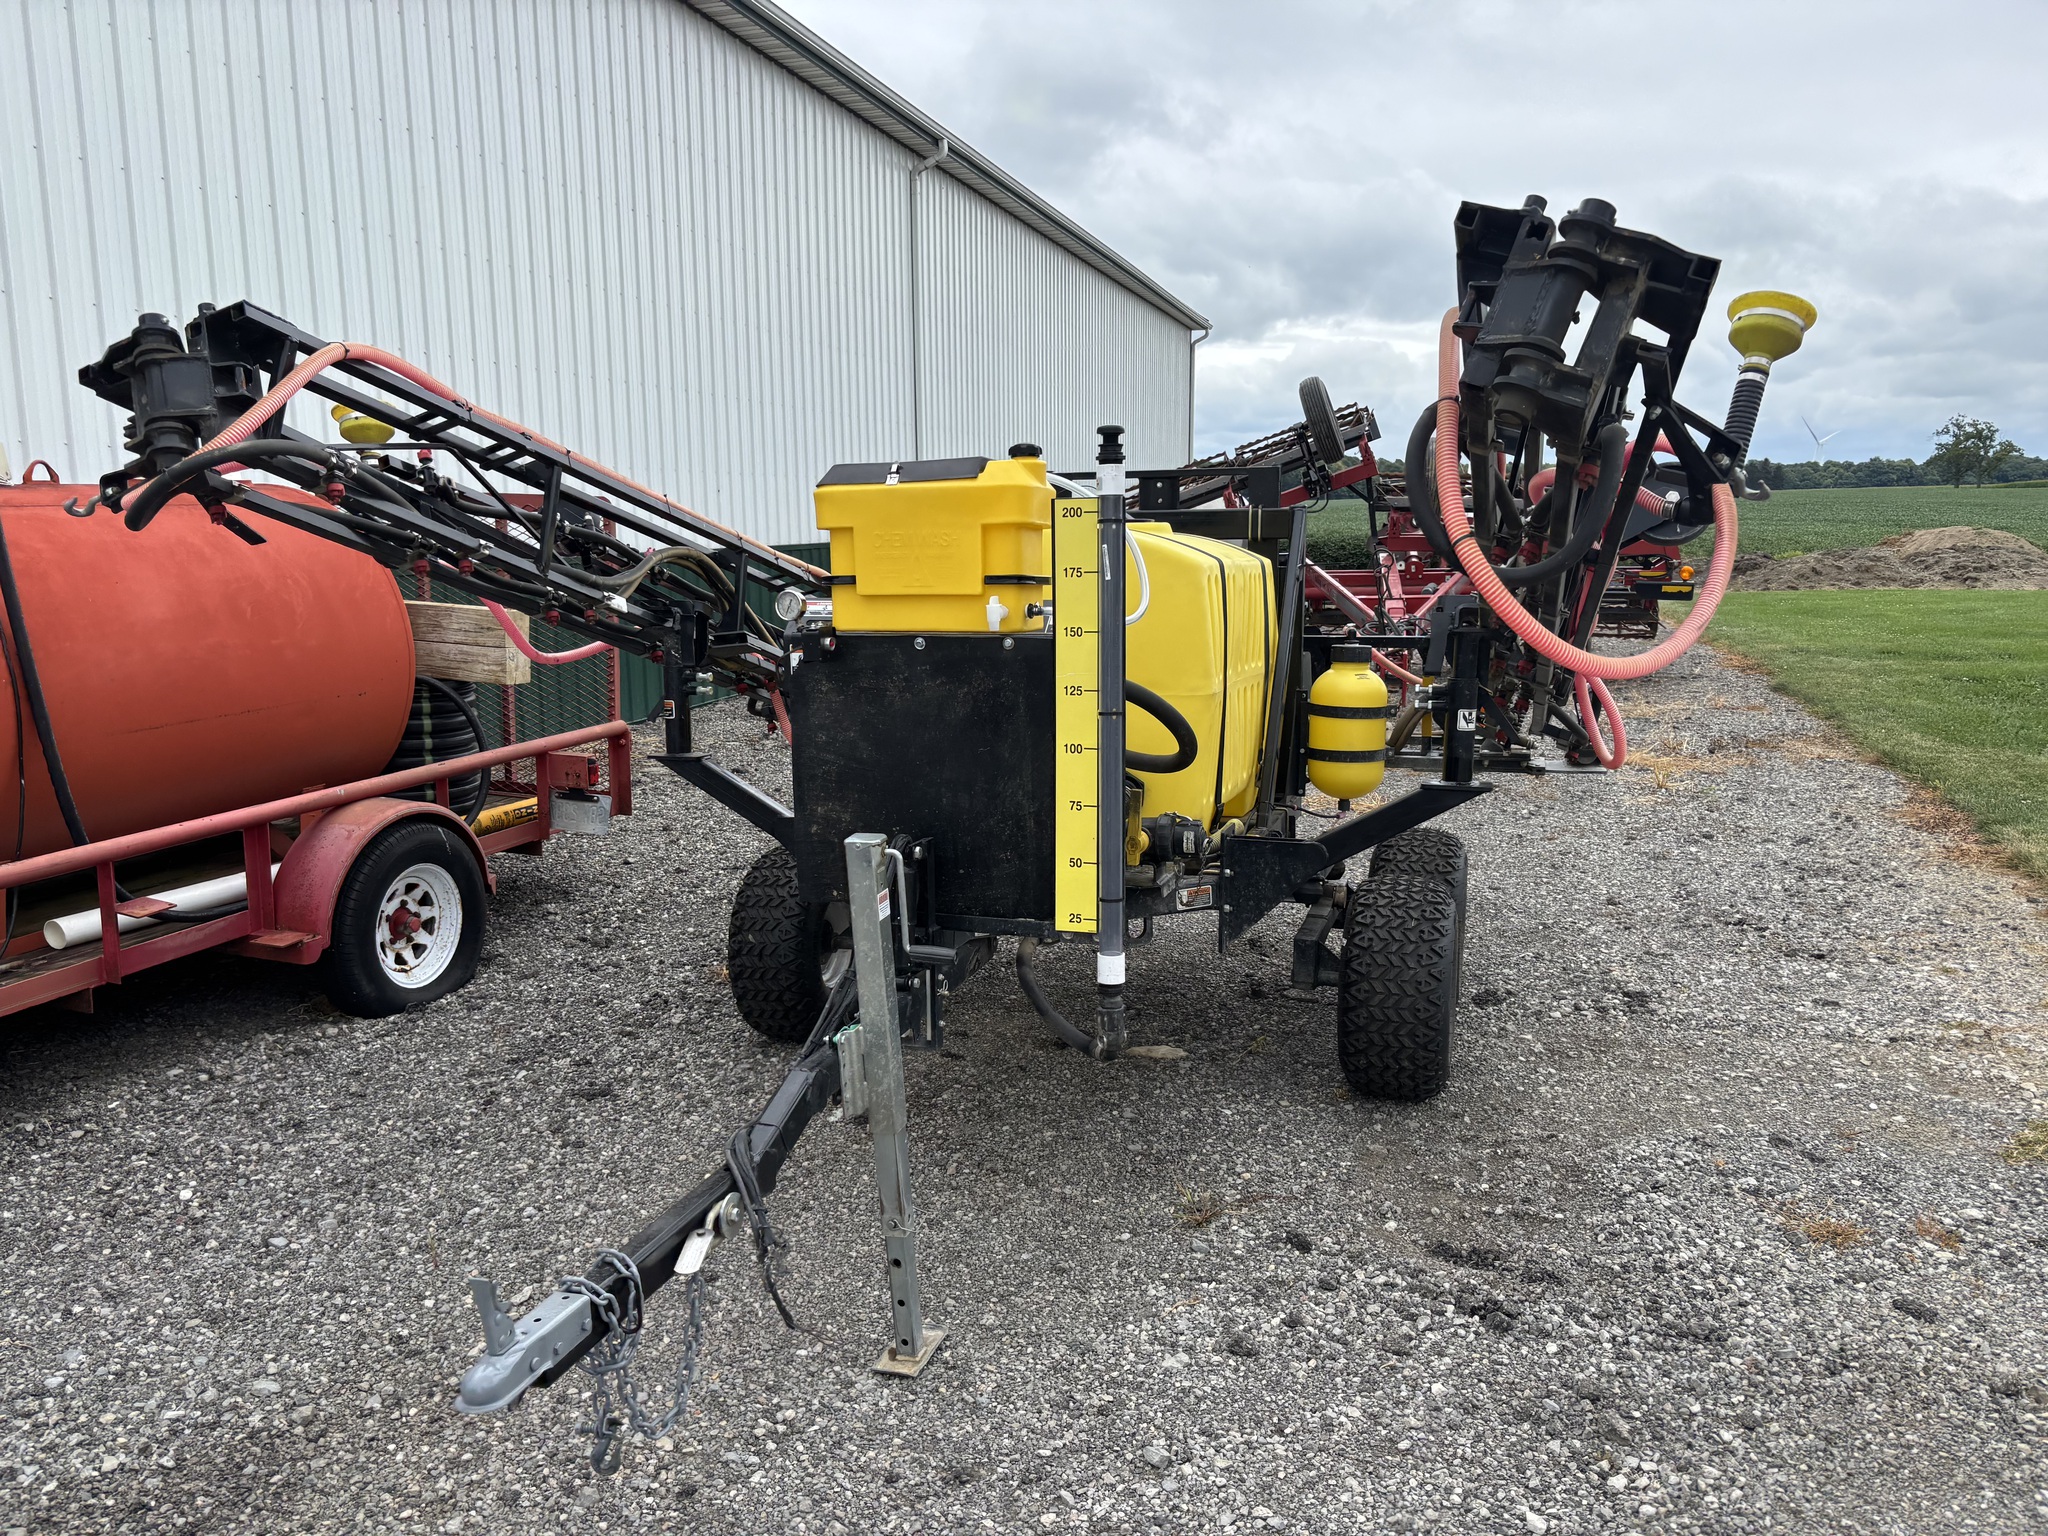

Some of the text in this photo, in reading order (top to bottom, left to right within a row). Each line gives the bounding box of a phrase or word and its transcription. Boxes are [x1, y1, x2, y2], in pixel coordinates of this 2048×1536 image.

[1061, 506, 1083, 518] 200
[1062, 567, 1083, 578] 175
[1062, 626, 1083, 638] 150
[1062, 685, 1083, 697] 125
[1062, 743, 1083, 755] 100
[1069, 800, 1083, 812] 75
[1069, 857, 1083, 869] 50
[1068, 912, 1083, 924] 25
